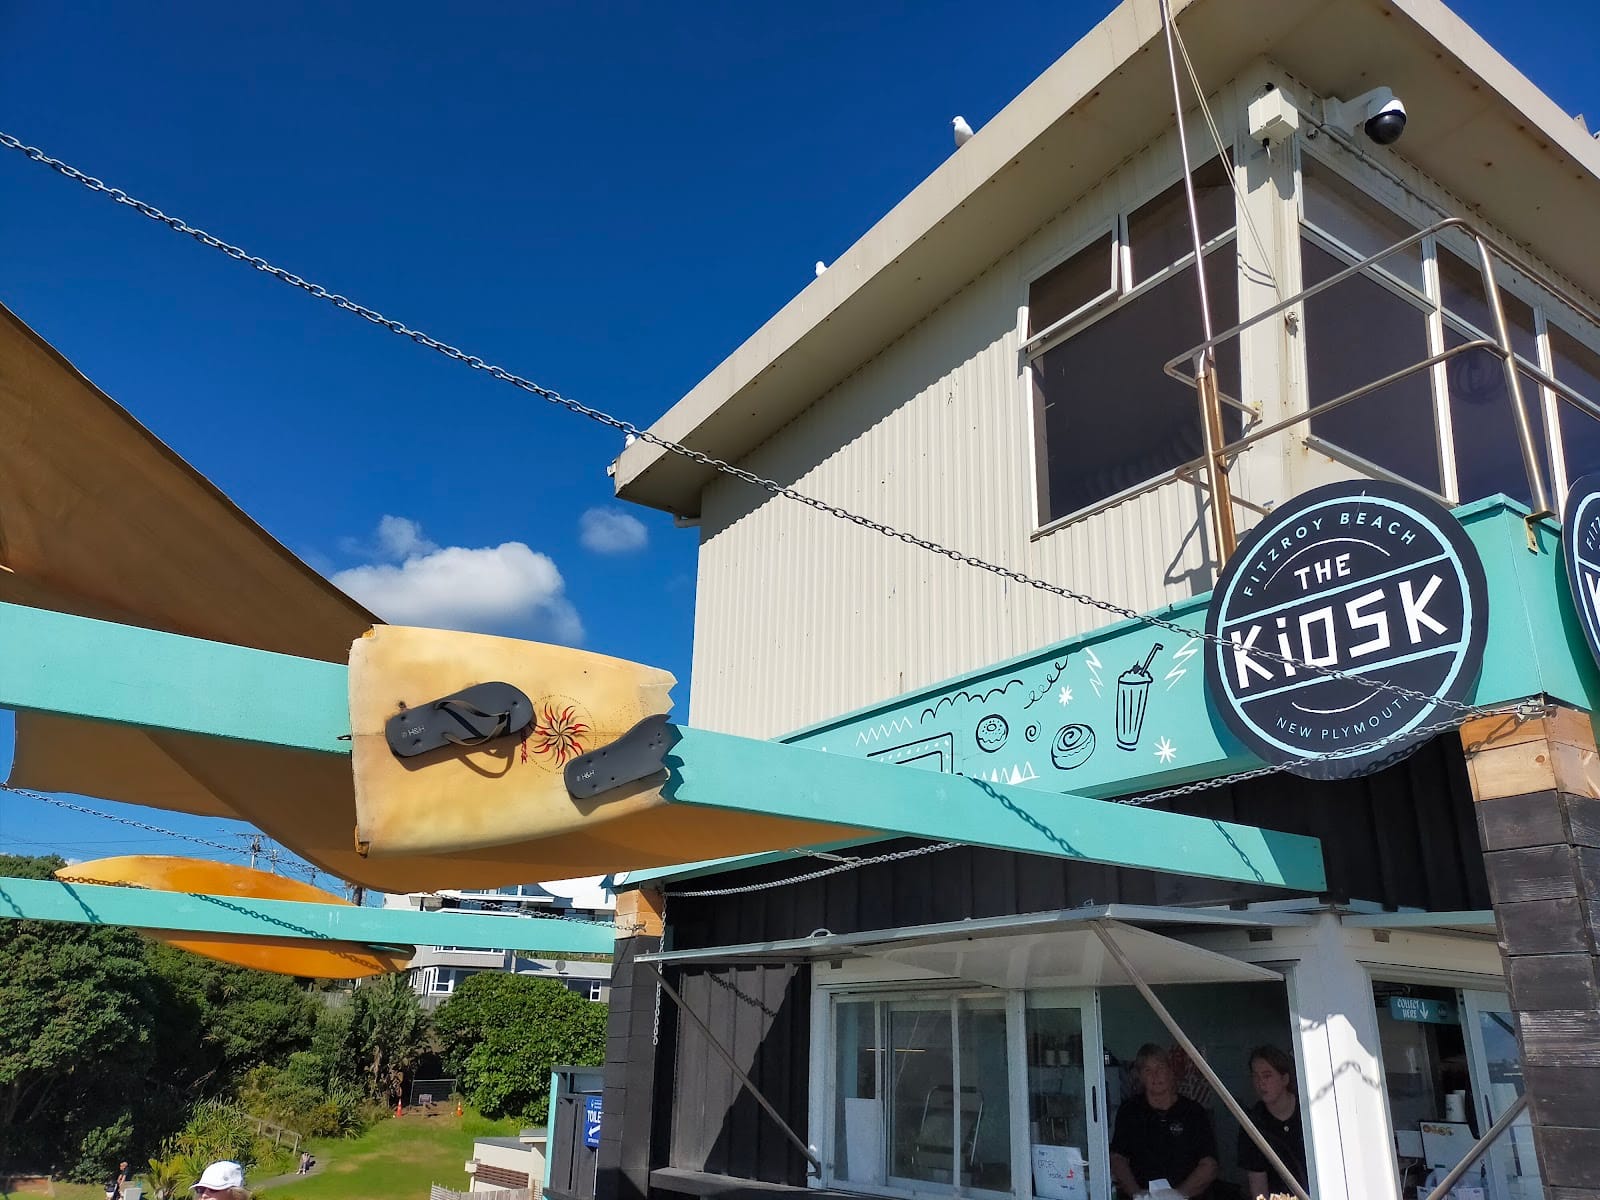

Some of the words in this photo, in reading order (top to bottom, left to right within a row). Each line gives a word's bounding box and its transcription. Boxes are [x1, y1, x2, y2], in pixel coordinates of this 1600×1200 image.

[1243, 518, 1322, 597] FITZROY
[1340, 512, 1416, 545] BEACH
[1293, 553, 1351, 590] THE
[1276, 717, 1312, 738] NEW
[1397, 998, 1420, 1009] COLLECT
[1402, 1009, 1417, 1019] HERE
[587, 1109, 603, 1124] TOILE
